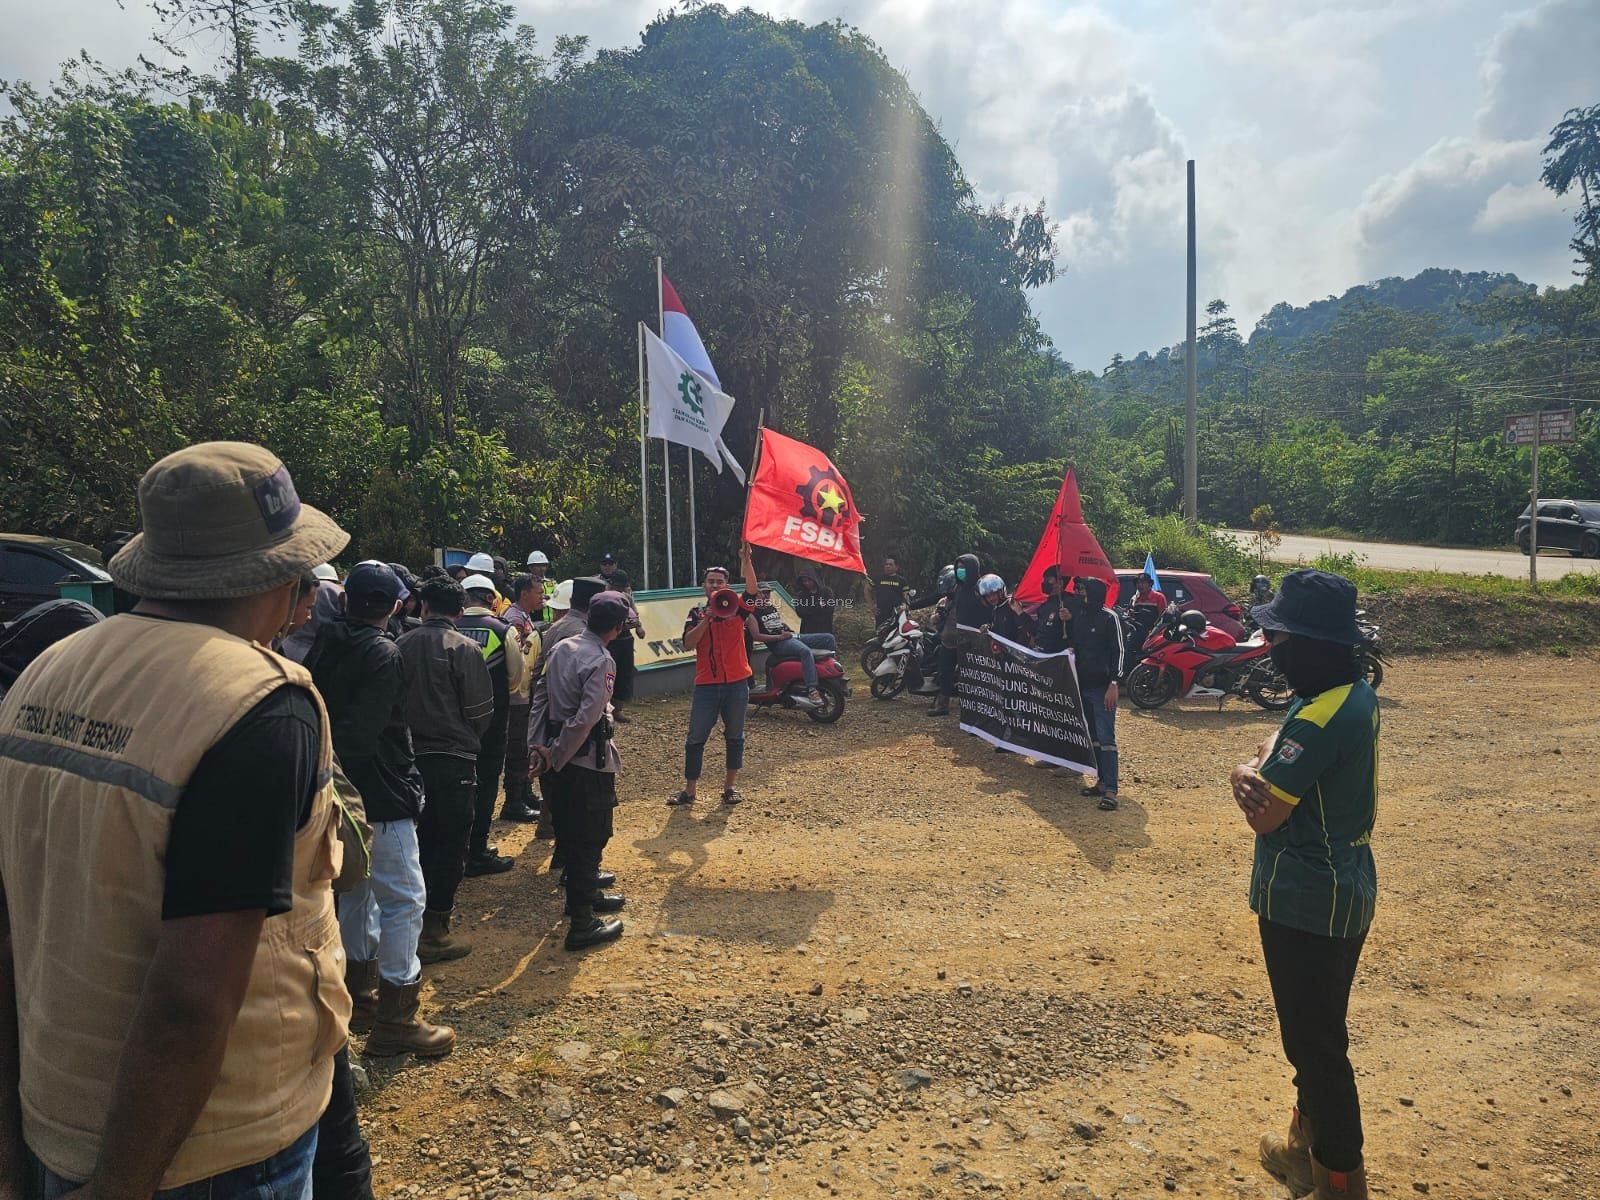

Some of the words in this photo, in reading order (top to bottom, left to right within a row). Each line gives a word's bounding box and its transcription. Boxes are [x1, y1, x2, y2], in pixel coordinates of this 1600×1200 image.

[959, 666, 980, 680] HARUS
[1054, 692, 1075, 708] ATAS
[959, 697, 976, 713] YANG
[82, 719, 134, 754] BERSAMA
